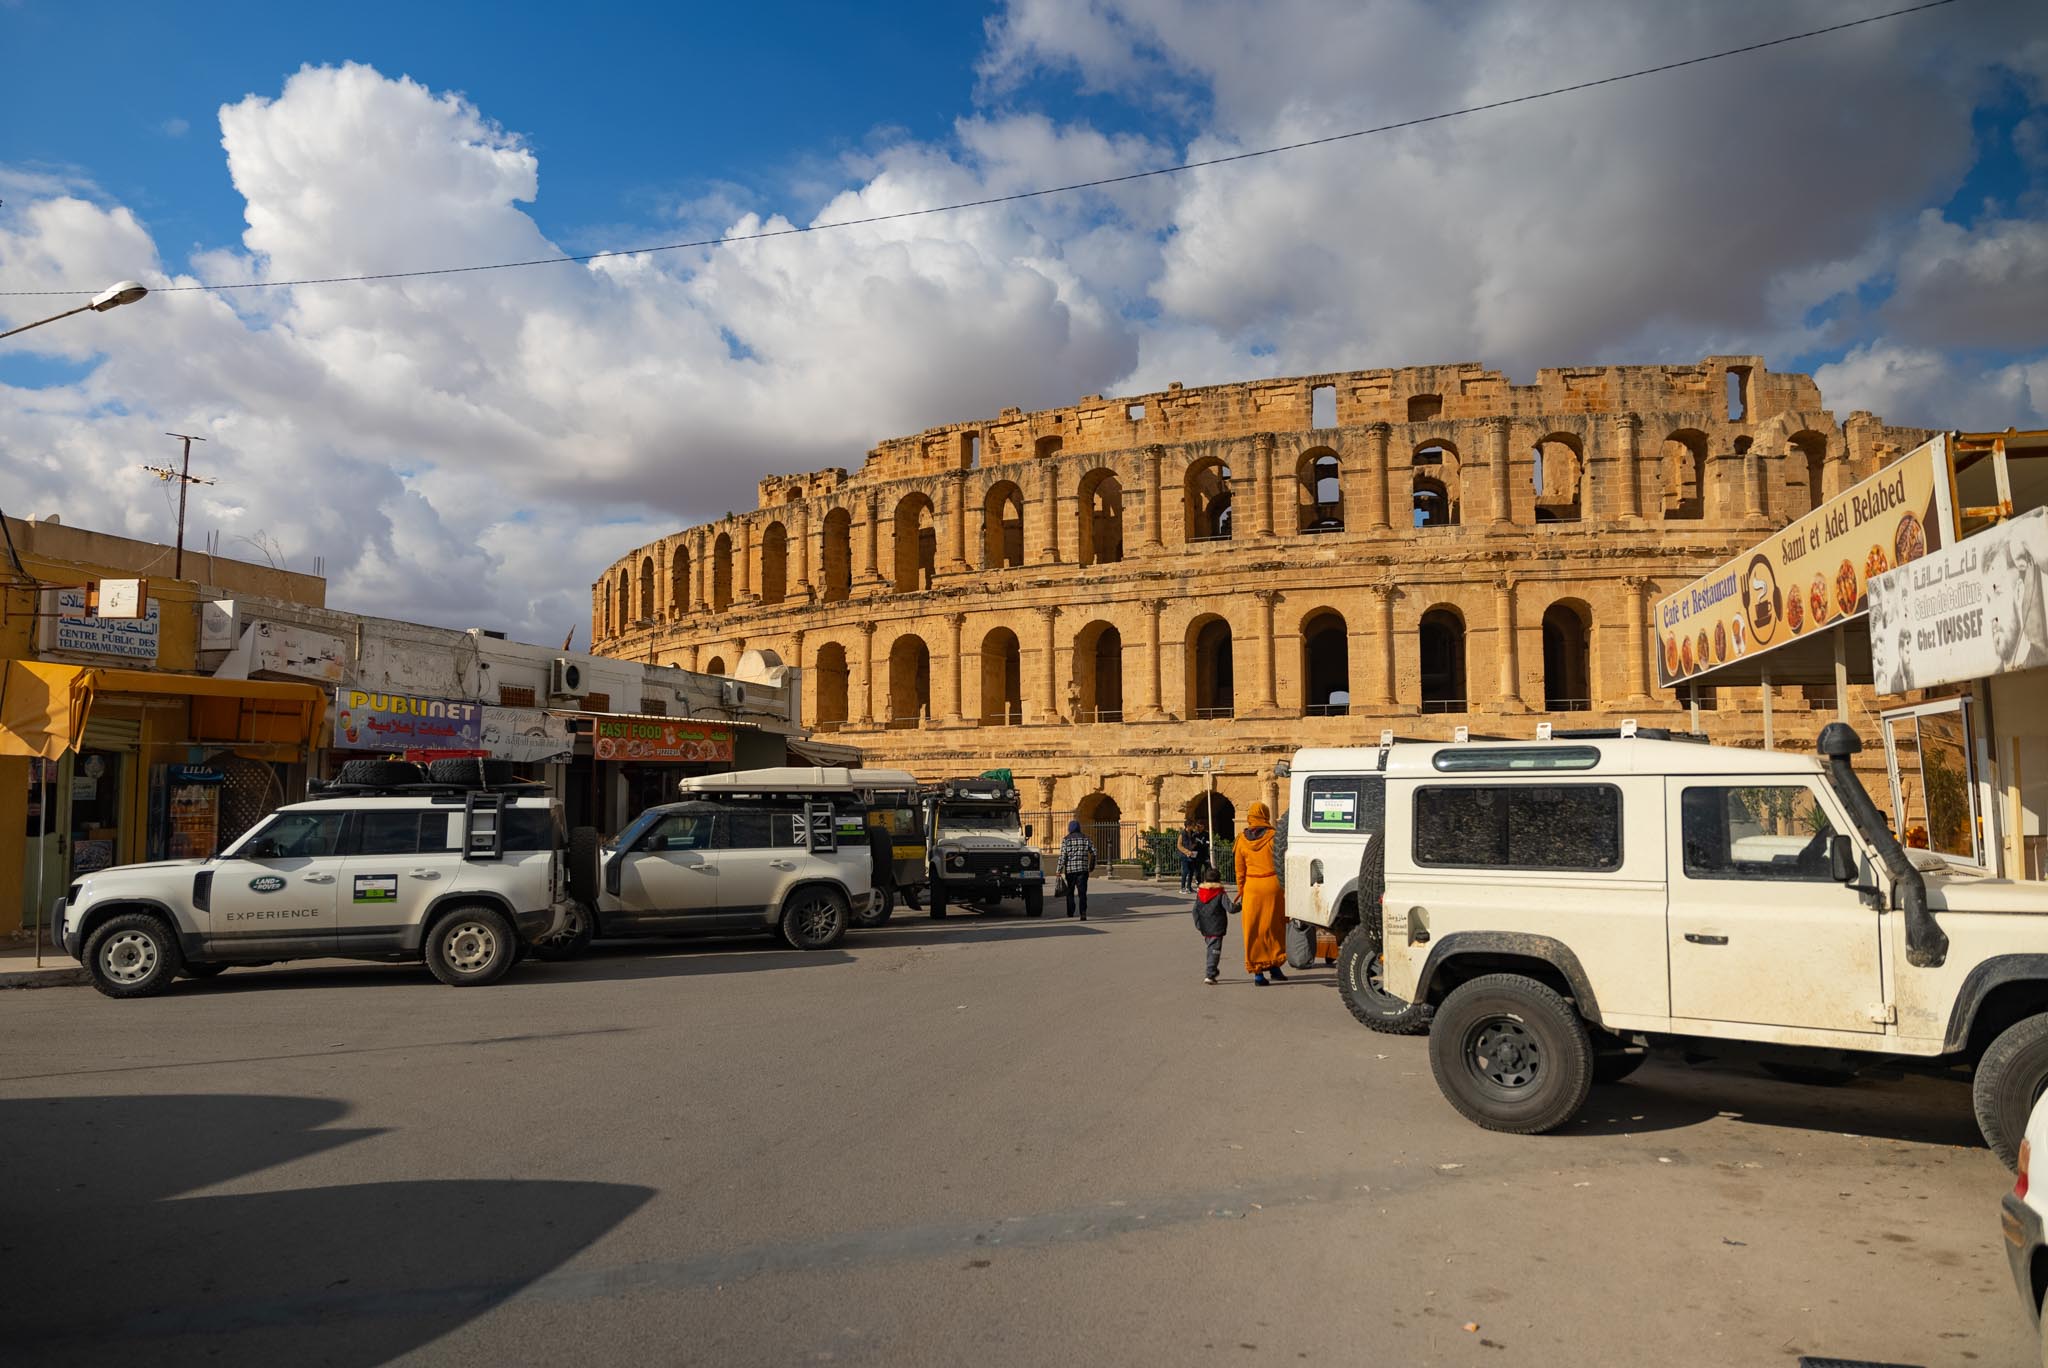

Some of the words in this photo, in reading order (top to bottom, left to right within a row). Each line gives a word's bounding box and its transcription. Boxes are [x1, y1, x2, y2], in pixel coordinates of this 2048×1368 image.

[1781, 526, 1807, 565] Sami
[1809, 521, 1820, 551] et
[1824, 500, 1849, 543] Adel
[1851, 468, 1906, 527] Belabed
[1913, 564, 1943, 591] حلاقة
[1944, 547, 1977, 580] قاعة
[1682, 597, 1690, 619] et
[1691, 570, 1738, 615] Restaurant
[1914, 592, 1937, 621] Salon
[60, 628, 97, 641] CENTRE
[102, 633, 135, 646] PUBLIC
[139, 638, 156, 648] DES
[1917, 627, 1937, 651] Chez
[1936, 608, 1984, 648] YOUSSEF
[59, 638, 157, 658] TELECOMMUNICATIONS
[349, 690, 475, 721] PUBLINET
[599, 722, 629, 738] FAST
[632, 725, 662, 740] FOOD
[182, 765, 213, 774] LILIA
[227, 908, 319, 921] EXPERIENCE
